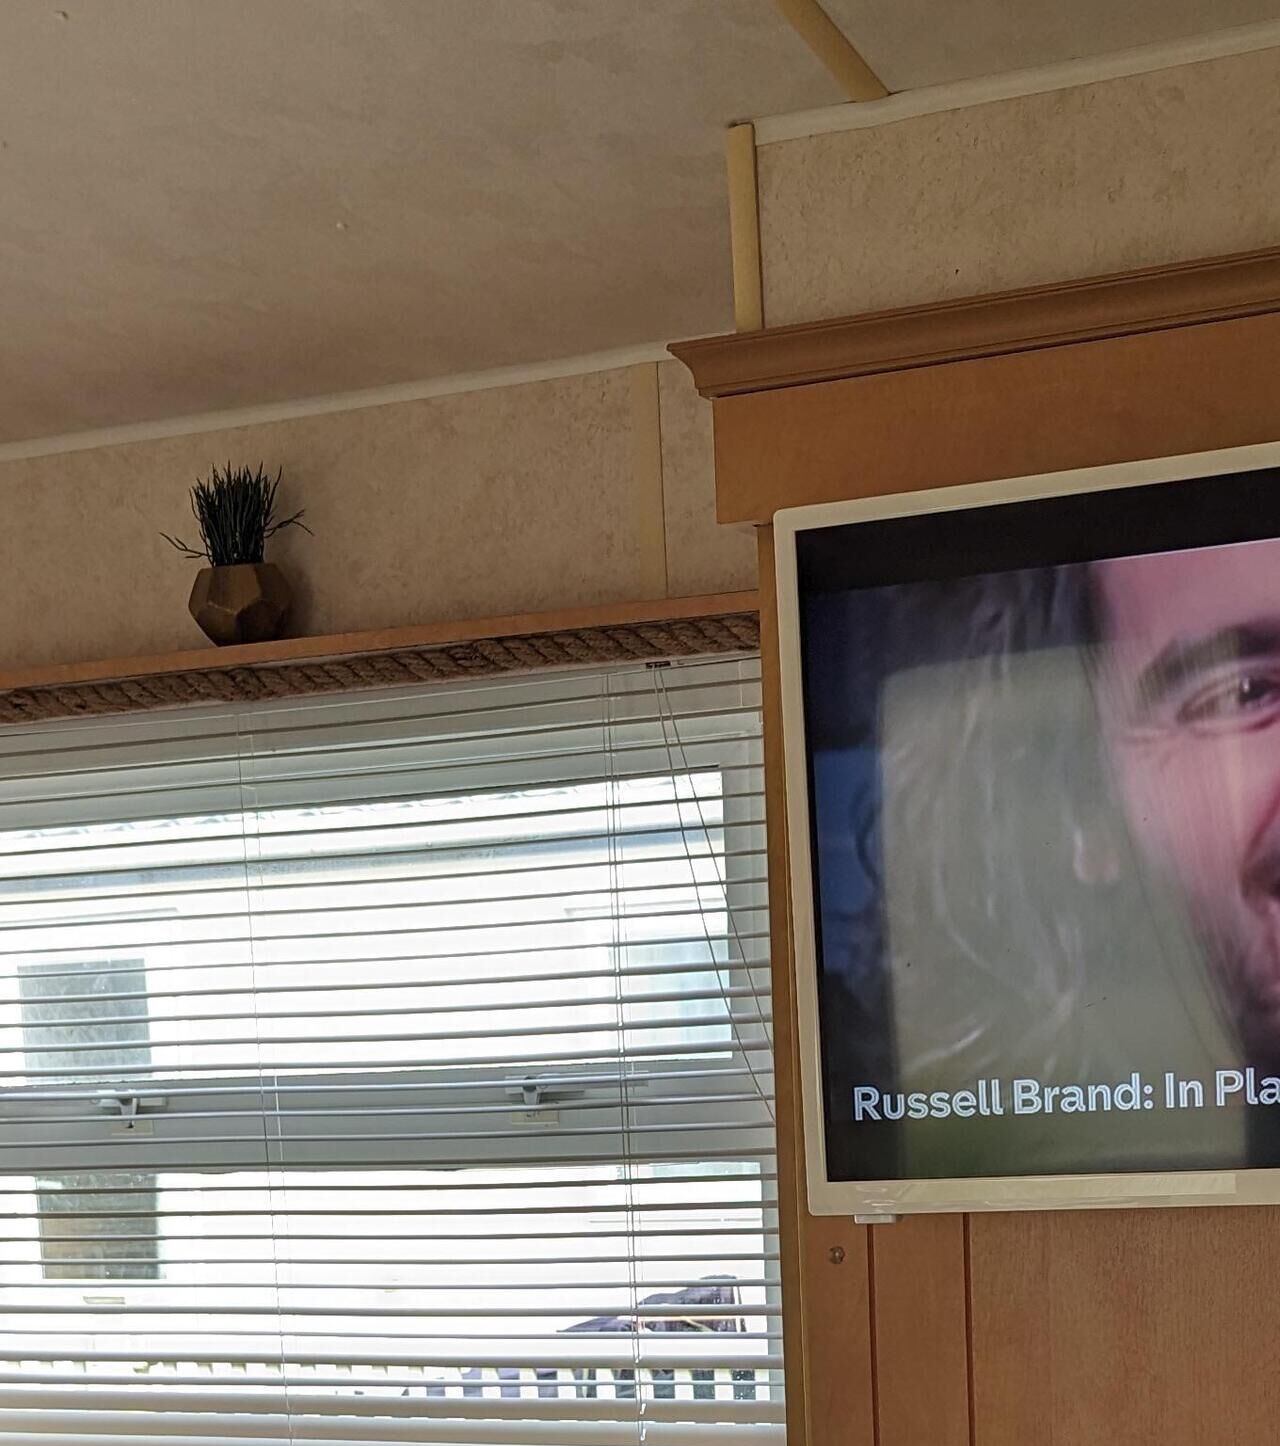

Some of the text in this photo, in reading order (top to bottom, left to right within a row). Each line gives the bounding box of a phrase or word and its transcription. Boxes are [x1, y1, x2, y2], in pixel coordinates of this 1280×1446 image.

[853, 1079, 1004, 1121] Russell
[1013, 1072, 1154, 1114] Brand:
[1165, 1072, 1204, 1108] In
